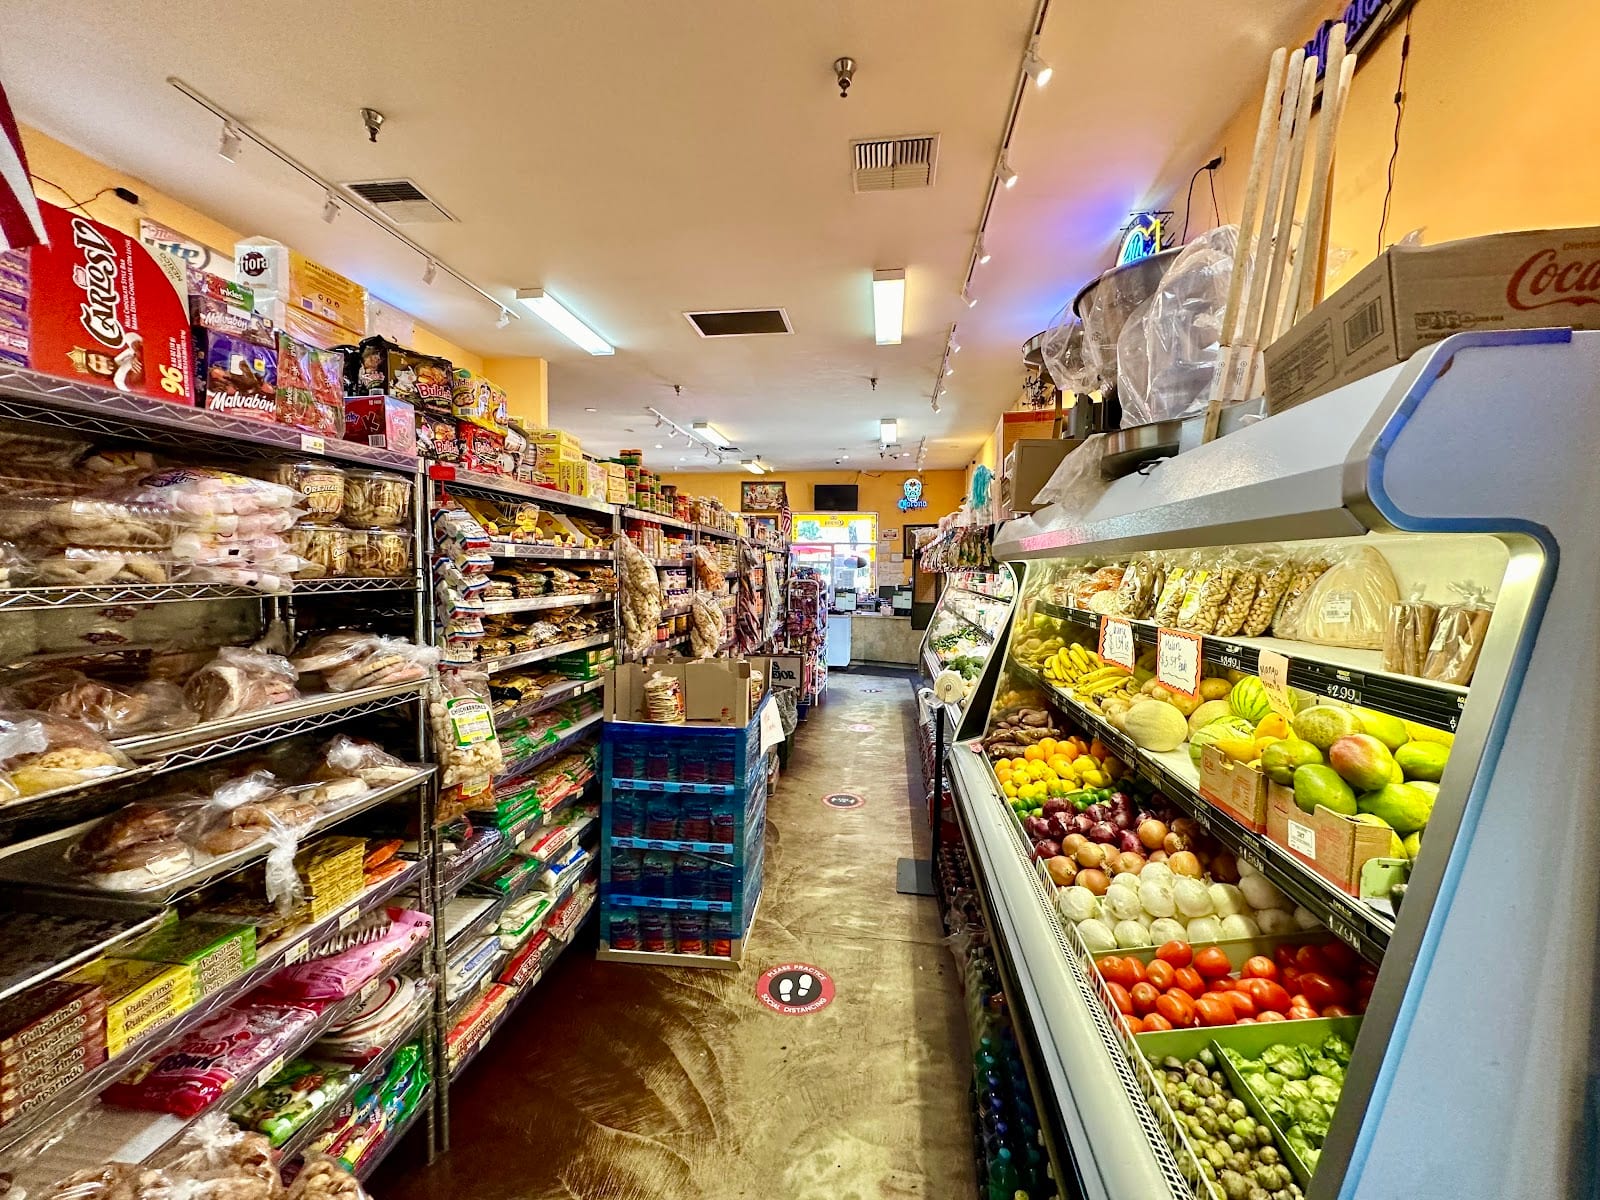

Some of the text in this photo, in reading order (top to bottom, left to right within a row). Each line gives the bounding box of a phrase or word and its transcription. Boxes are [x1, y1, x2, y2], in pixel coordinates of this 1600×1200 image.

[240, 254, 269, 273] fiora
[121, 284, 130, 314] CHOCOLATE
[159, 364, 184, 396] 96
[897, 498, 928, 511] Corona
[1326, 683, 1356, 701] $2.99
[201, 936, 243, 968] Pulparindo
[767, 964, 827, 981] PLEASE PRACTICE
[123, 978, 176, 1017] Pulparindo
[123, 993, 175, 1032] Pulparindo
[761, 993, 827, 1014] SOCIAL DISTANCING
[19, 999, 82, 1048] Pulparindo
[23, 1014, 87, 1062] Pulparindo
[21, 1047, 86, 1097] Pulparindo
